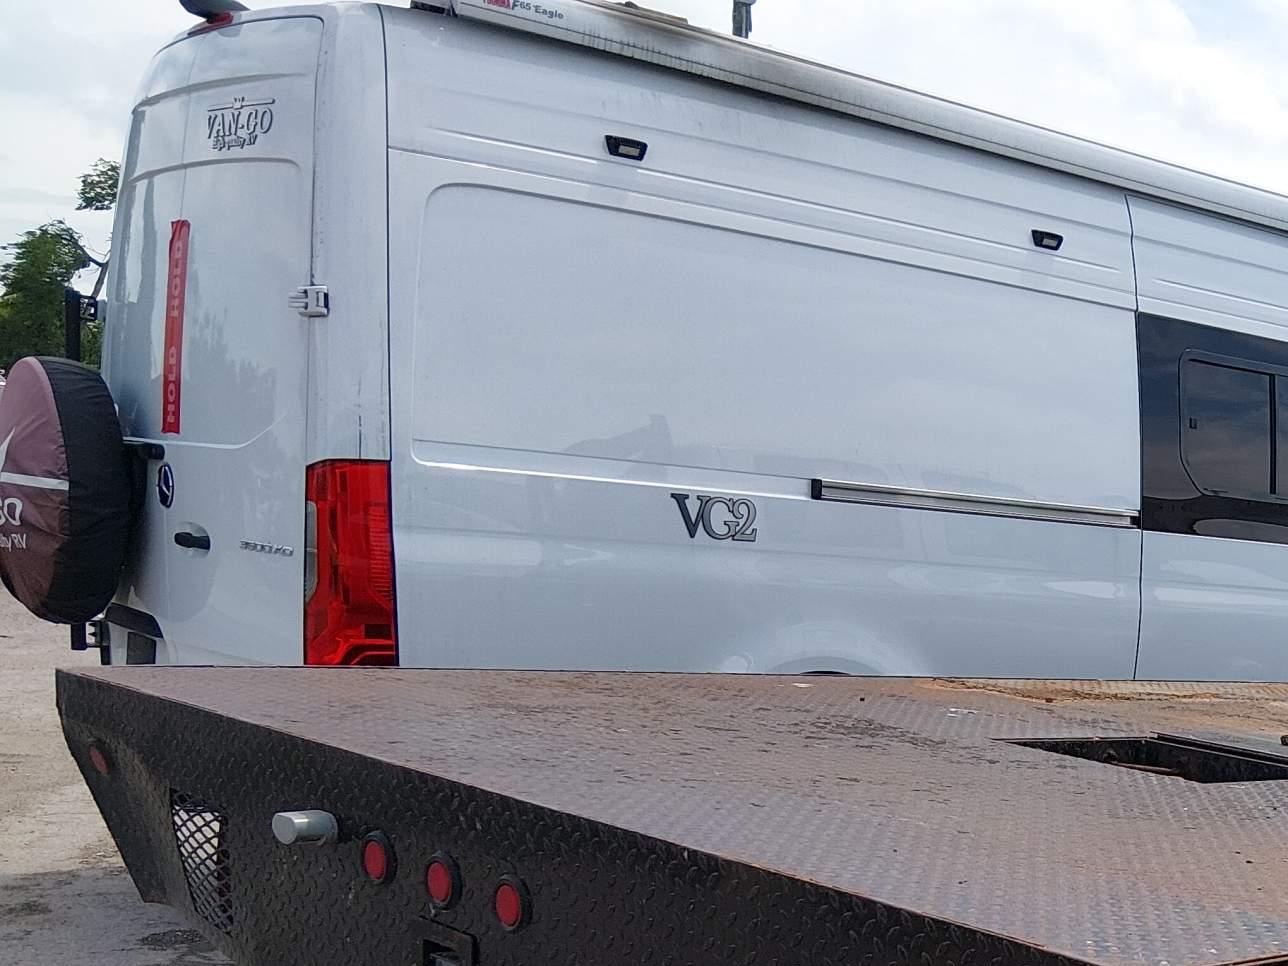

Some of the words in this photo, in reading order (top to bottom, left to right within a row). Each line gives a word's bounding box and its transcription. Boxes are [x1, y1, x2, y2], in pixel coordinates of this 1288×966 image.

[171, 240, 183, 318] HOLD
[166, 346, 177, 423] HOLD
[670, 493, 757, 542] VG2
